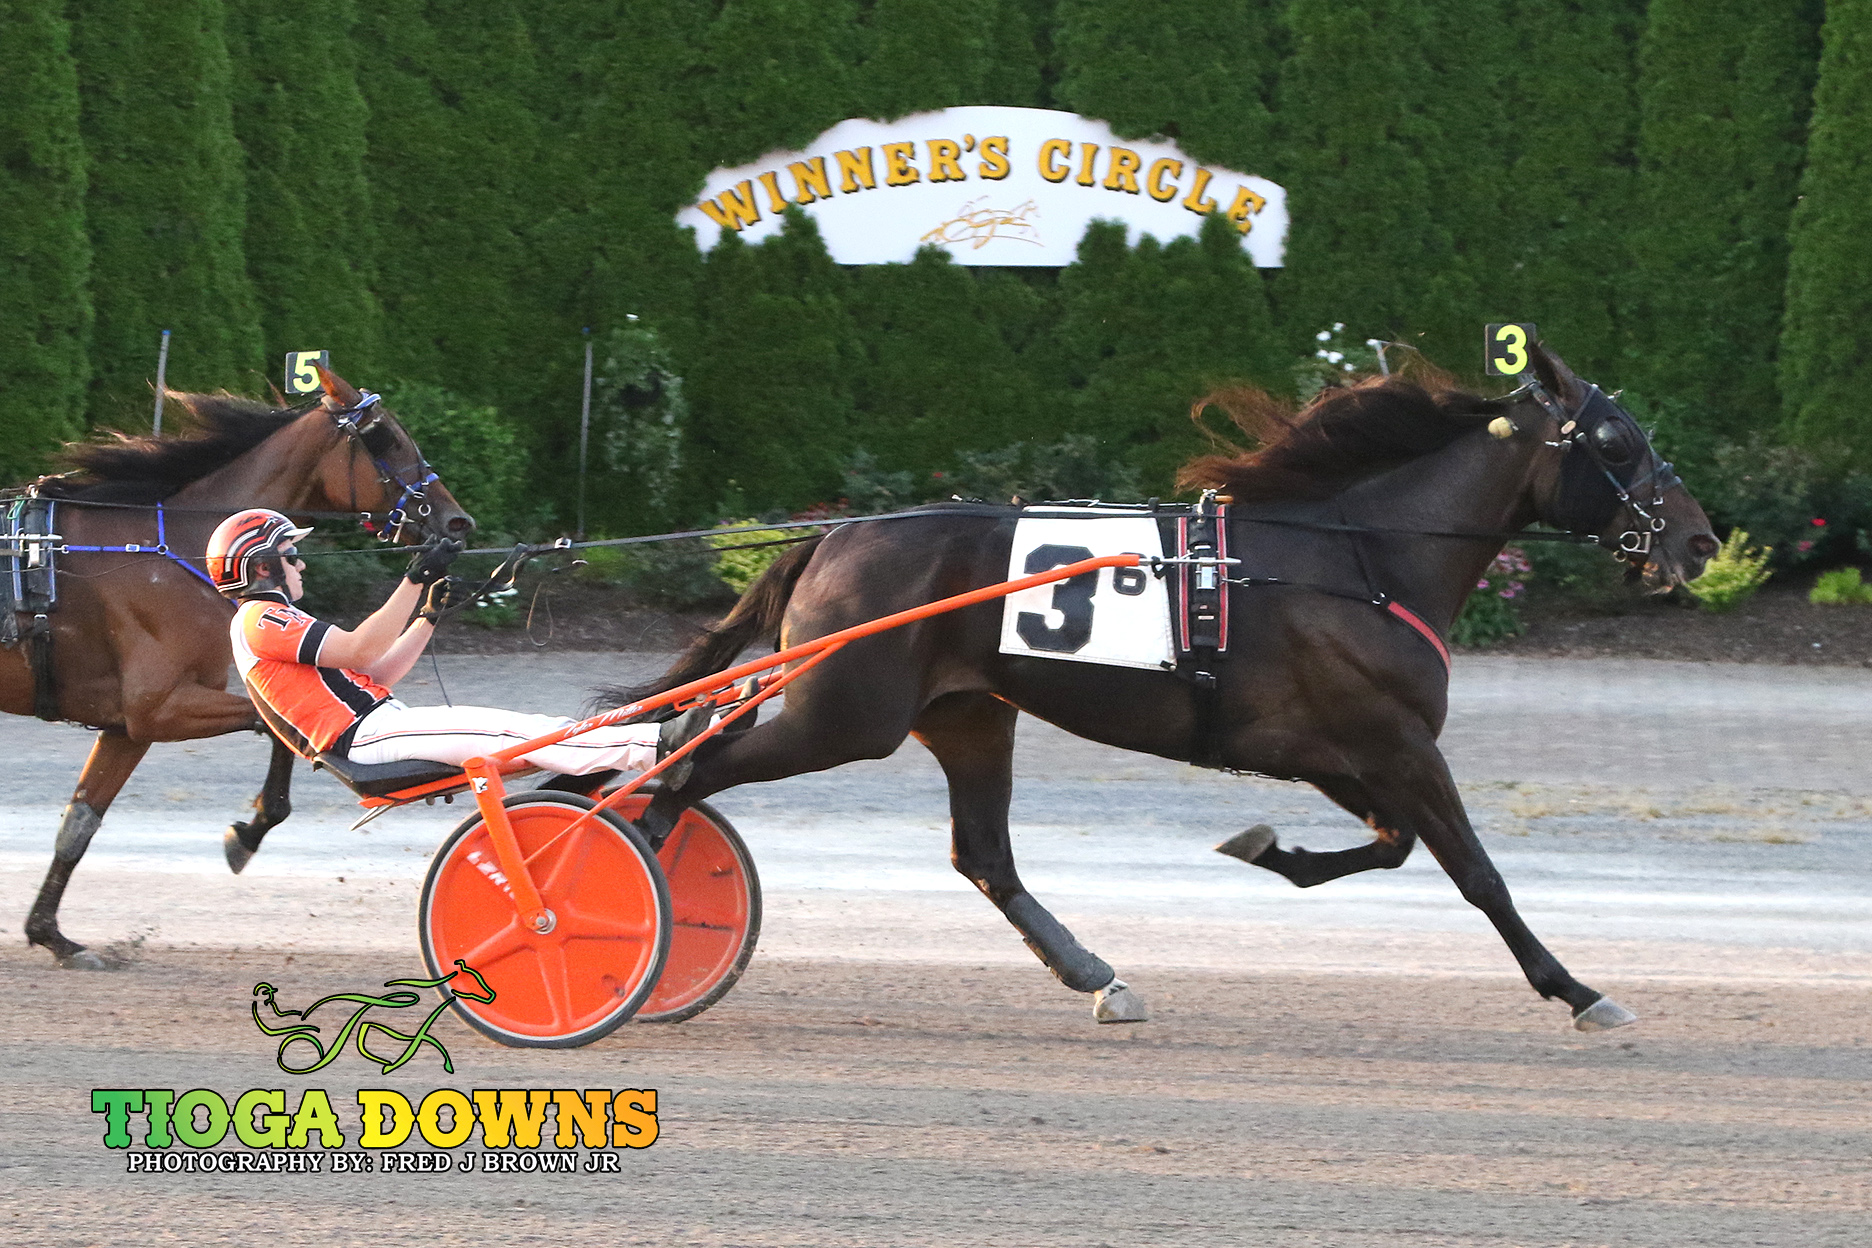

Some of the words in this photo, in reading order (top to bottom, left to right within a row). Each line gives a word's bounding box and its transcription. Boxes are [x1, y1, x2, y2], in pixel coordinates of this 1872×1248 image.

[698, 134, 1010, 231] WINNER'S
[1037, 138, 1266, 236] CIRCLE
[293, 351, 321, 392] 5
[1494, 324, 1528, 375] 3
[1016, 543, 1100, 653] 3
[1113, 552, 1147, 596] 6
